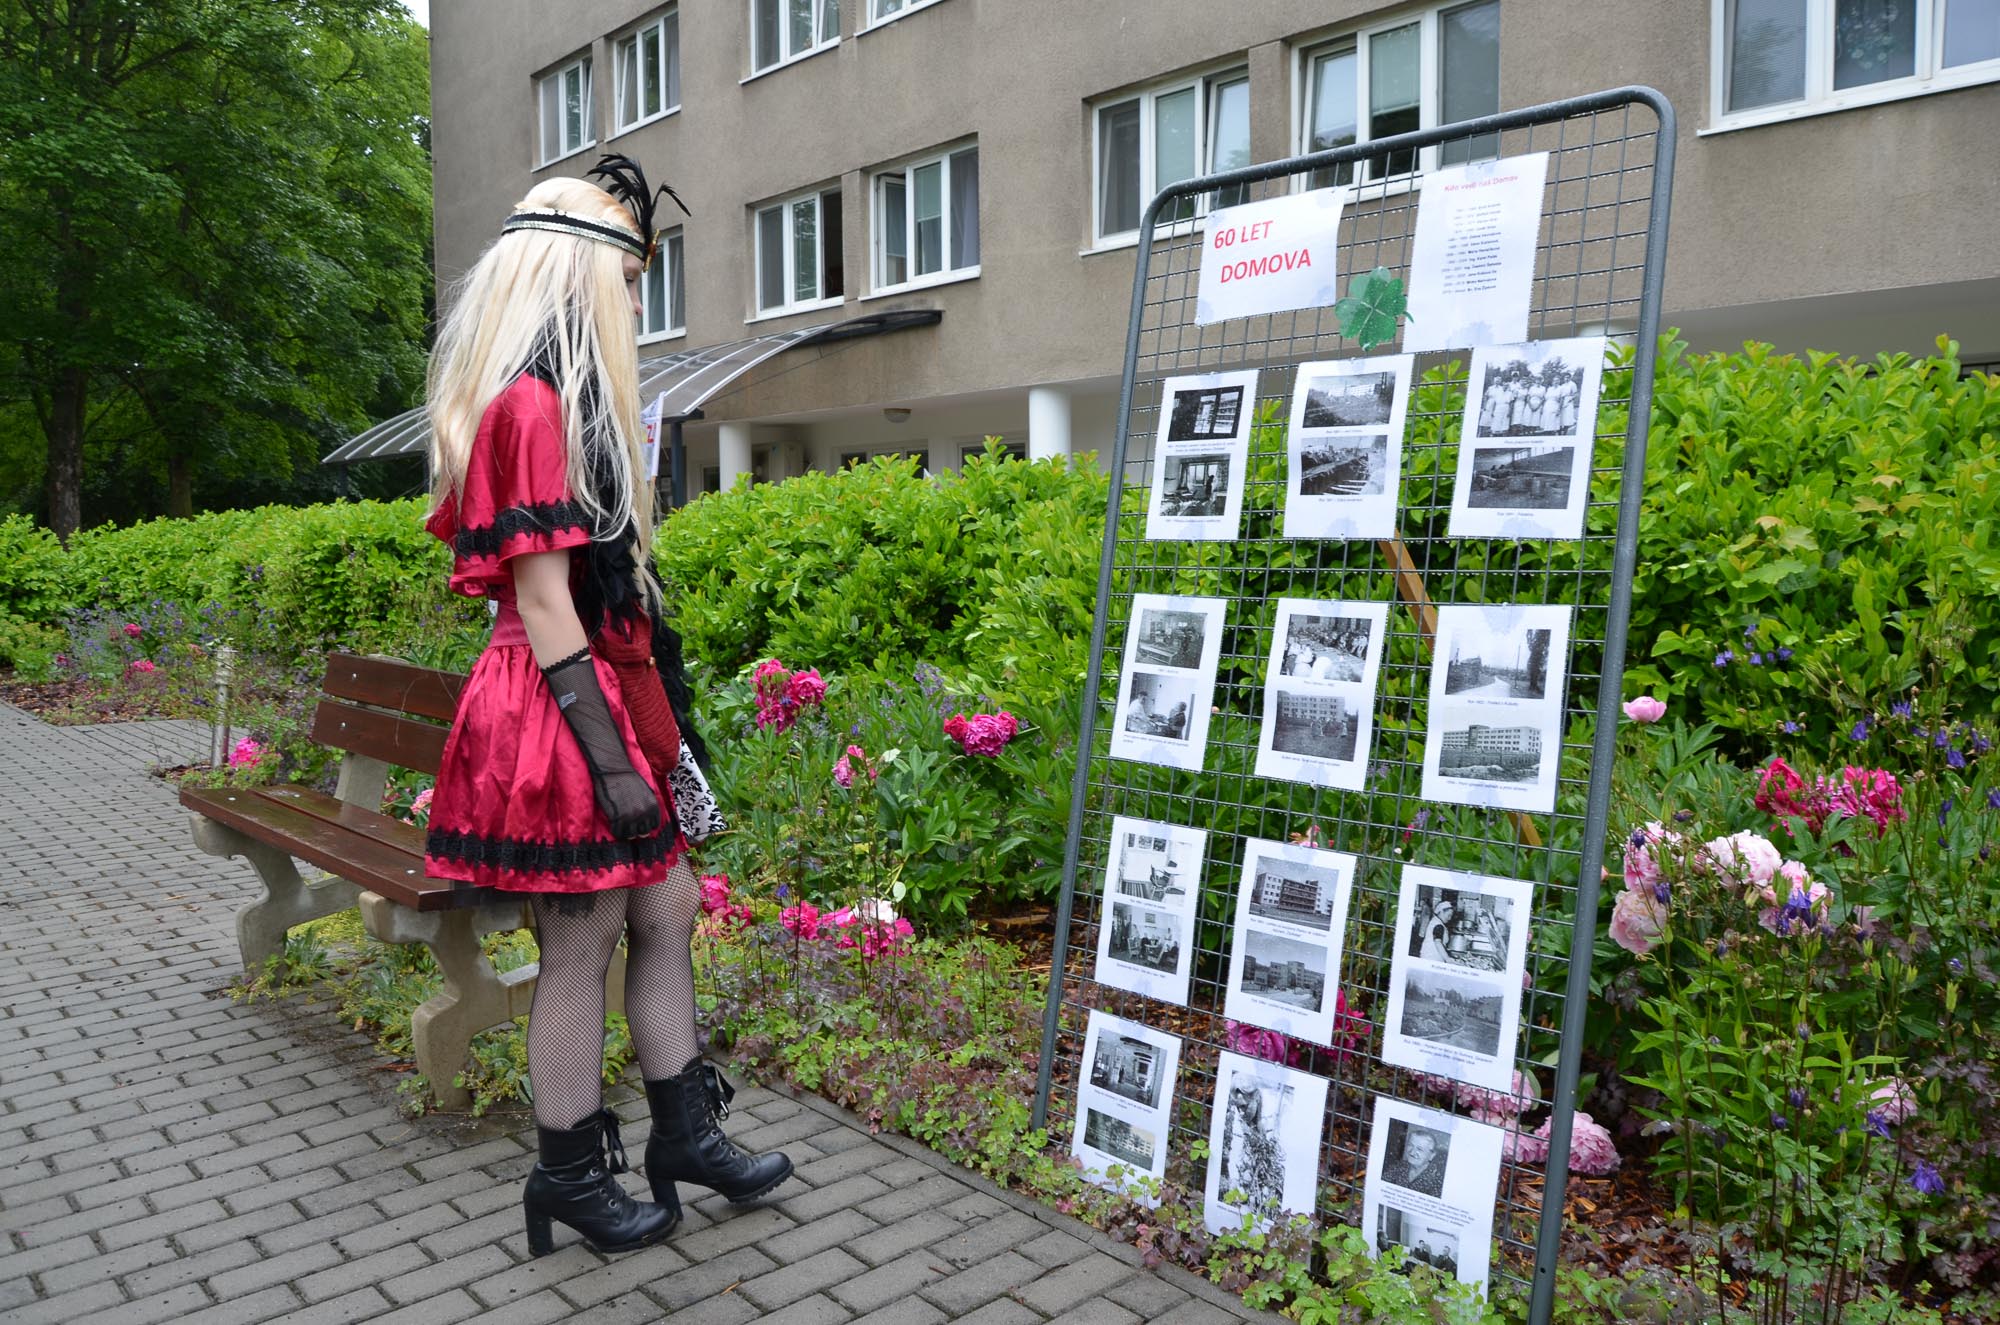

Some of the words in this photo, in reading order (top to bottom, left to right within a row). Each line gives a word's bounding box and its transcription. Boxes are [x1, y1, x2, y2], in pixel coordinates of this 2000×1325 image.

[1214, 227, 1236, 249] 60
[1240, 220, 1274, 243] LET
[1220, 248, 1312, 284] DOMOVA
